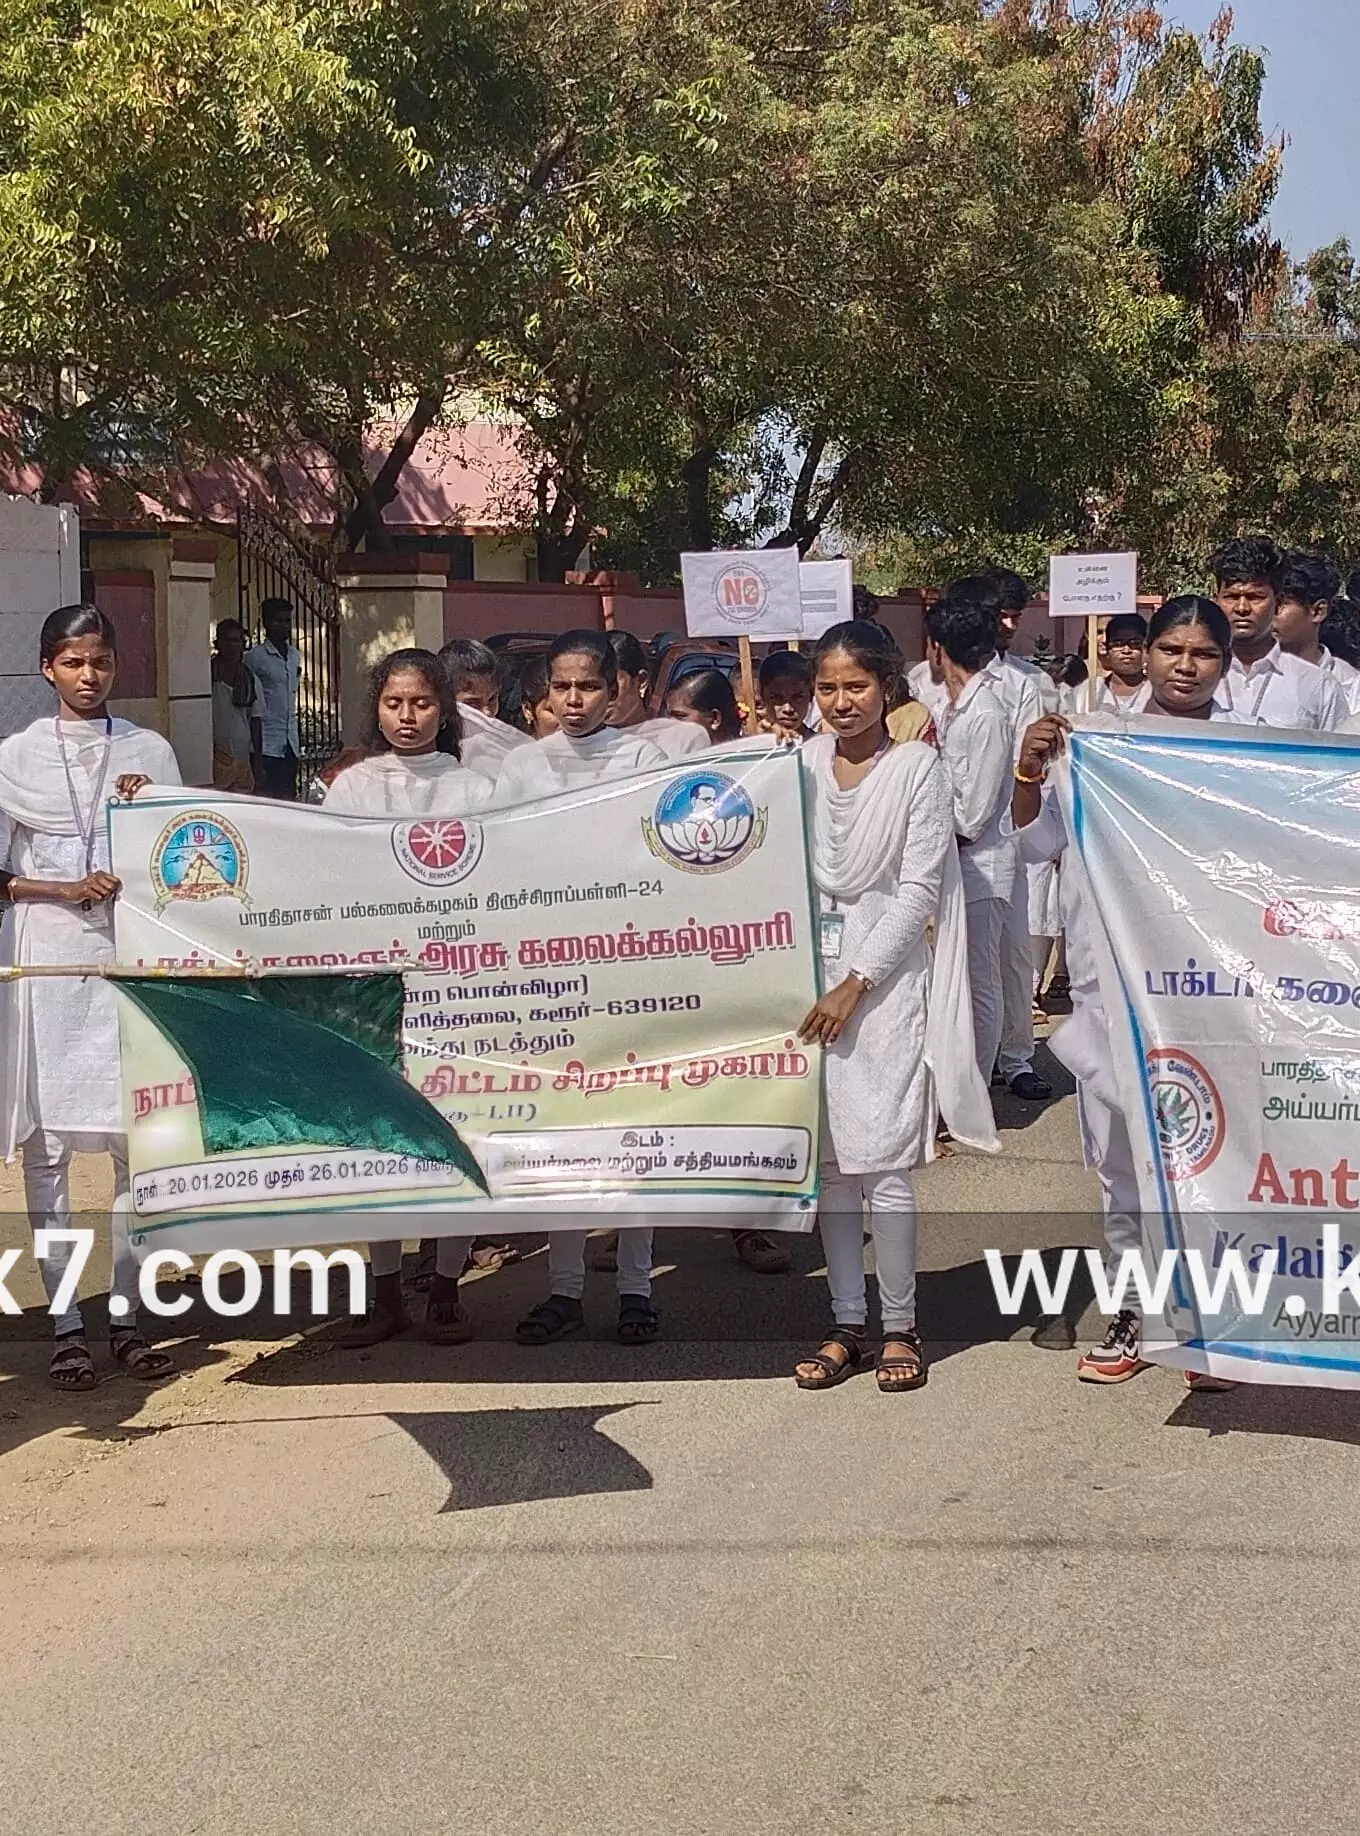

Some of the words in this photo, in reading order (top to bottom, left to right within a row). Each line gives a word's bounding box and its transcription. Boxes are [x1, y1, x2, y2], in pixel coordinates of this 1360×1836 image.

[723, 577, 760, 606] NO
[240, 901, 334, 928] பாரதிதாசன்
[341, 891, 479, 921] பல்கலைக்கழகம்
[418, 919, 476, 943] மற்றும்
[518, 912, 796, 966] கலைக்கல்லூரி
[553, 1051, 672, 1099] சிறப்பு
[681, 1038, 810, 1086] முகாம்
[620, 1130, 664, 1150] இடம்
[169, 1170, 259, 1195] 20.01.2026
[264, 1164, 305, 1190] முதல்
[310, 1156, 410, 1181] 26.01.2026
